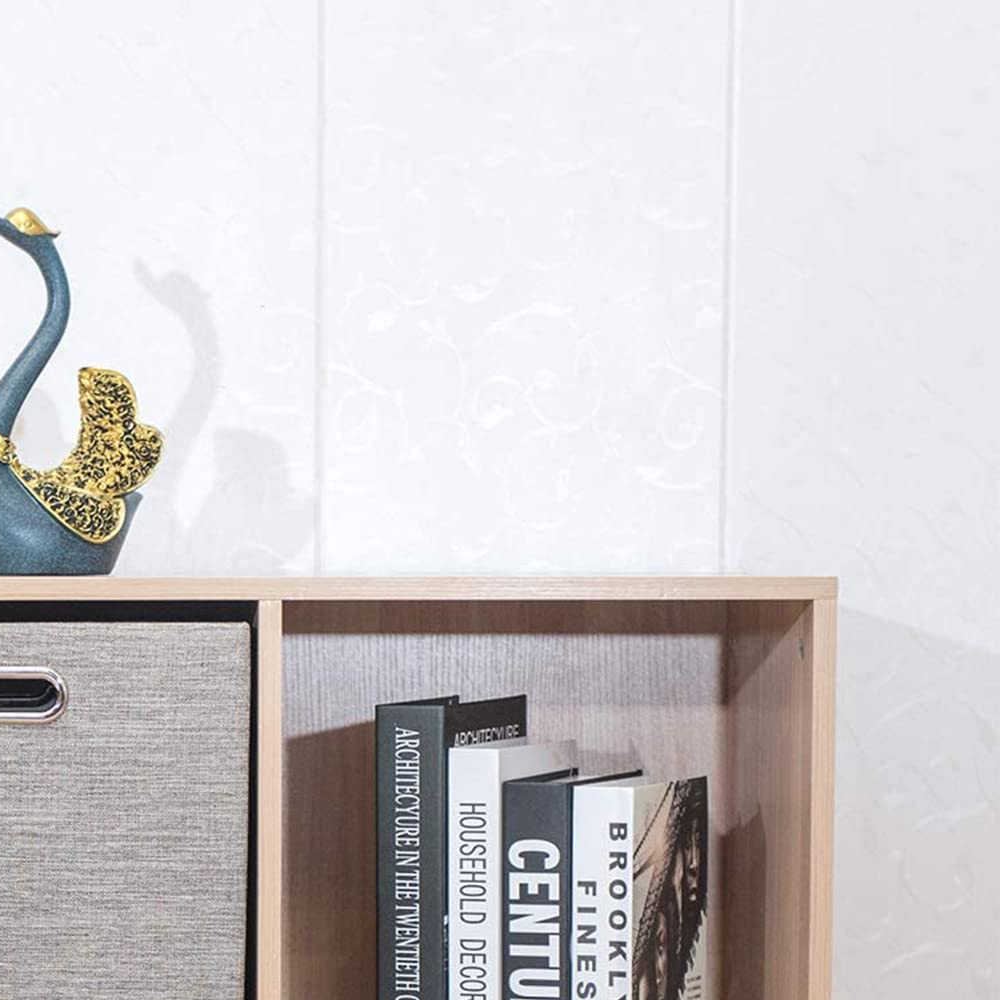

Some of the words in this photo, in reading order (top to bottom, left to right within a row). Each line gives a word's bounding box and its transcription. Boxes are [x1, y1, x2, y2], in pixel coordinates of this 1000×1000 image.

[394, 727, 420, 847] ARCHITECYURE
[394, 850, 420, 867] IN
[394, 869, 420, 900] THE
[459, 803, 487, 924] HOUSEHOLD
[394, 903, 420, 991] TWENTIETH
